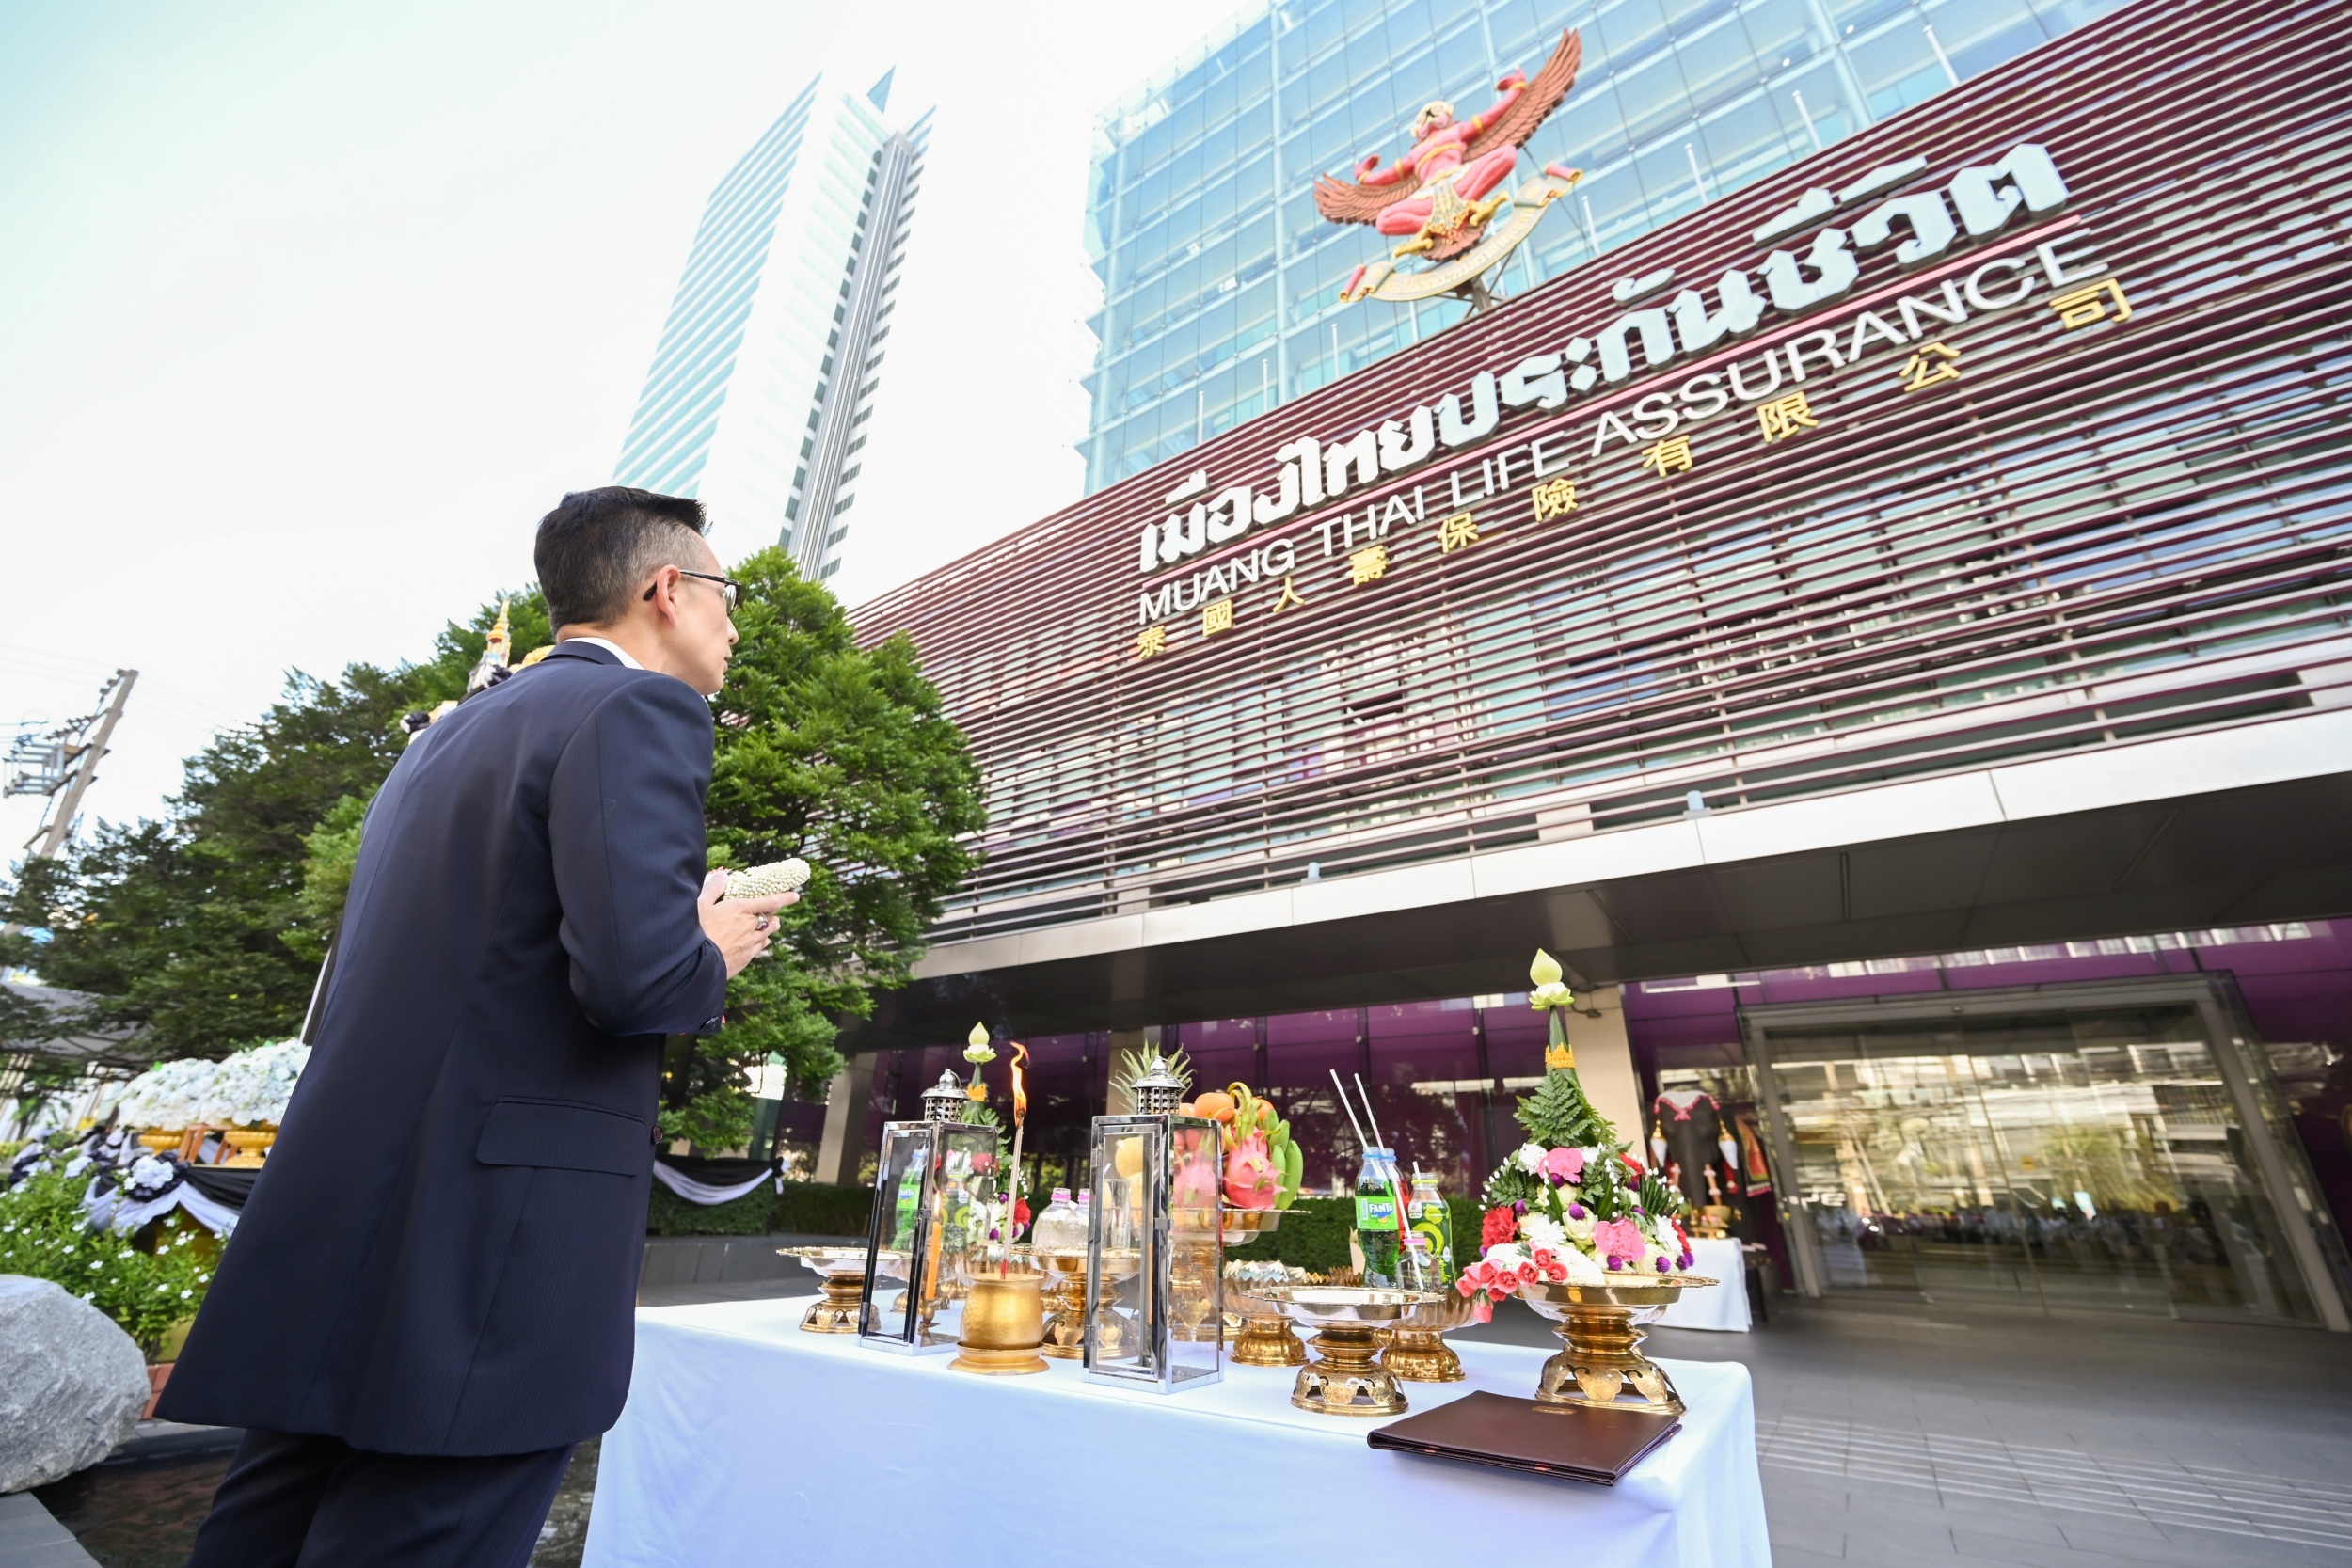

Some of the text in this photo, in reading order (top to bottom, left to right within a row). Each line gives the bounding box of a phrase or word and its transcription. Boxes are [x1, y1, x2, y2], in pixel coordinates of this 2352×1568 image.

[1138, 142, 2070, 574] เมืองไทยประกันชีวิต
[1139, 537, 1295, 625] MUANG
[1311, 485, 1426, 555] THAI
[1450, 430, 1570, 508] LIFE
[1590, 228, 2110, 458] ASSURANCE
